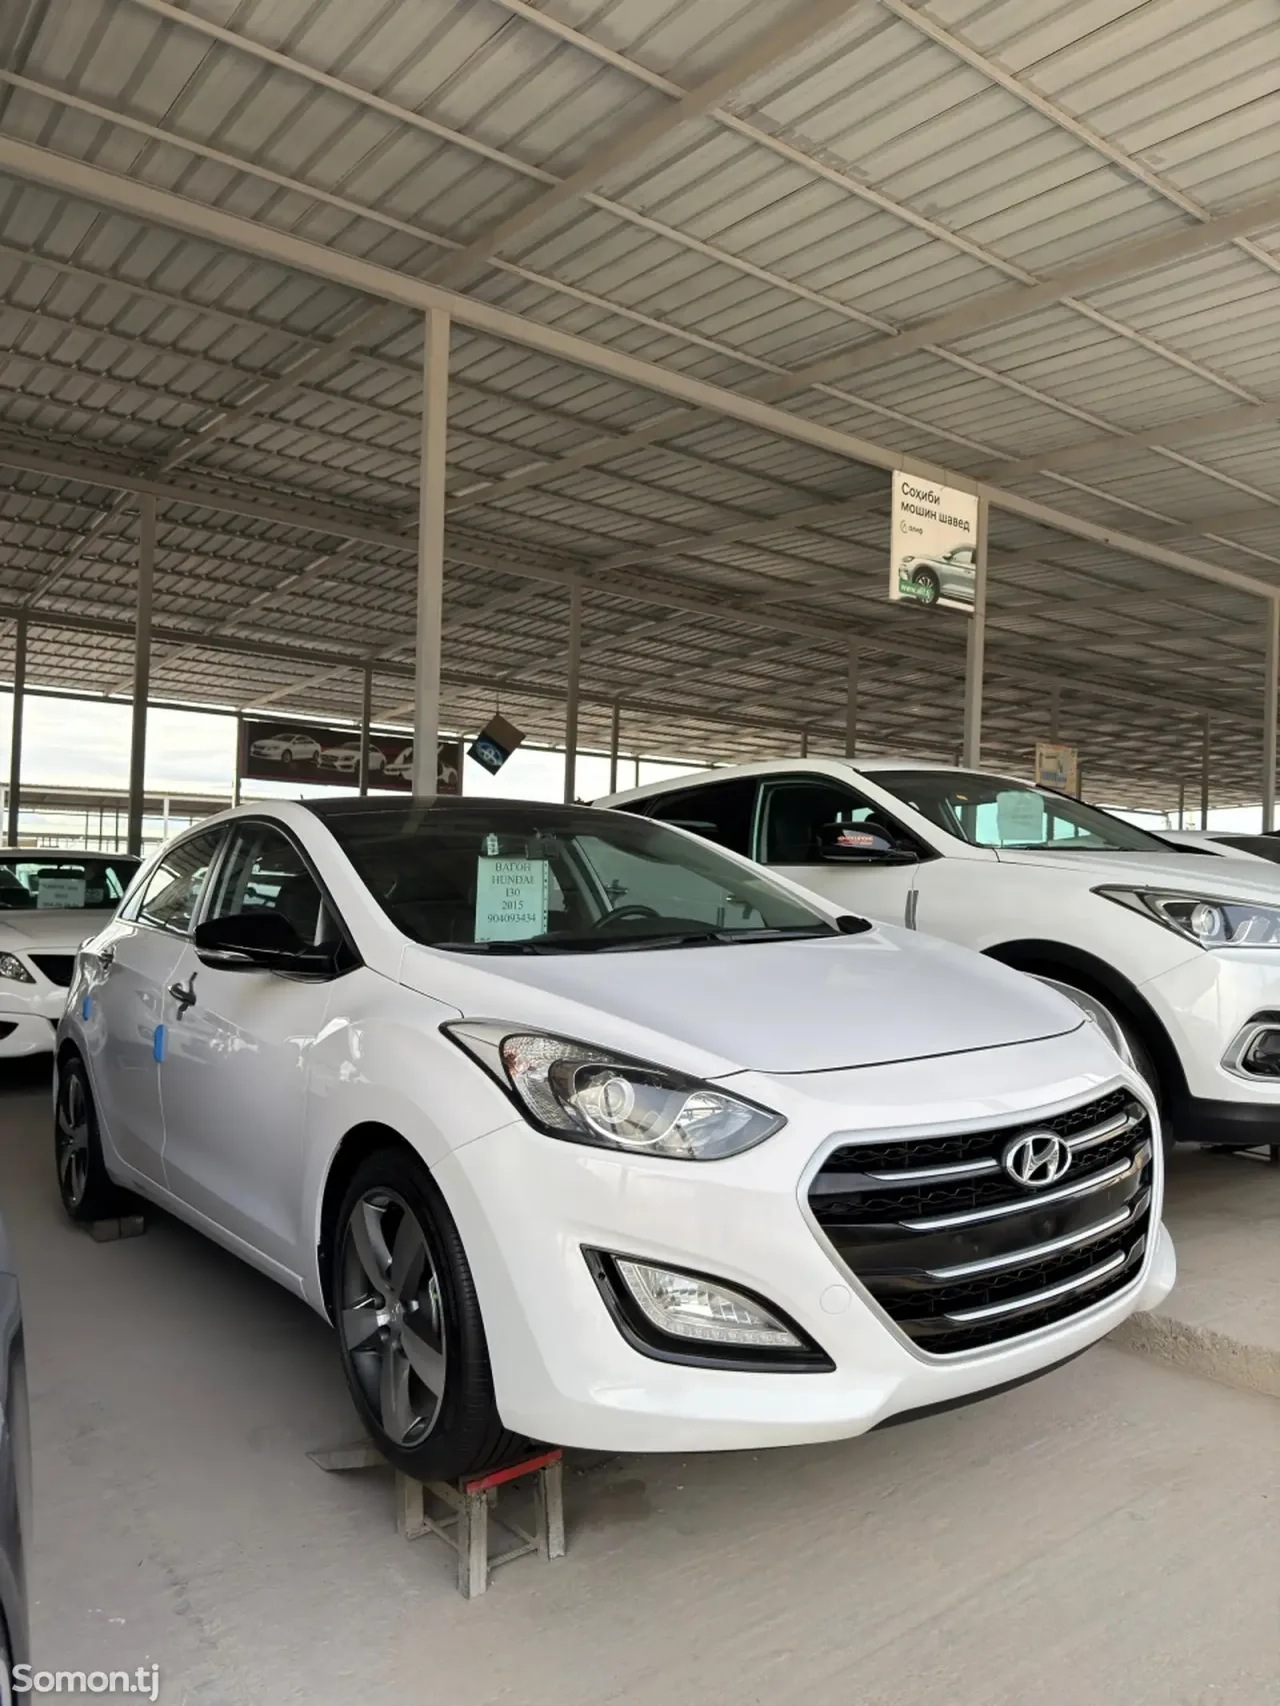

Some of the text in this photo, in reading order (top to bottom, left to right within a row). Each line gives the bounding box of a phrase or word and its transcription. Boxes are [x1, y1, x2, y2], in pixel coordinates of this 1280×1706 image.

[901, 482, 941, 505] Соҳиби
[901, 501, 970, 533] мошин шавед
[495, 862, 532, 872] ВАГОН
[492, 875, 534, 884] HUNDAI
[502, 900, 524, 910] 2015
[487, 913, 536, 923] 904093434
